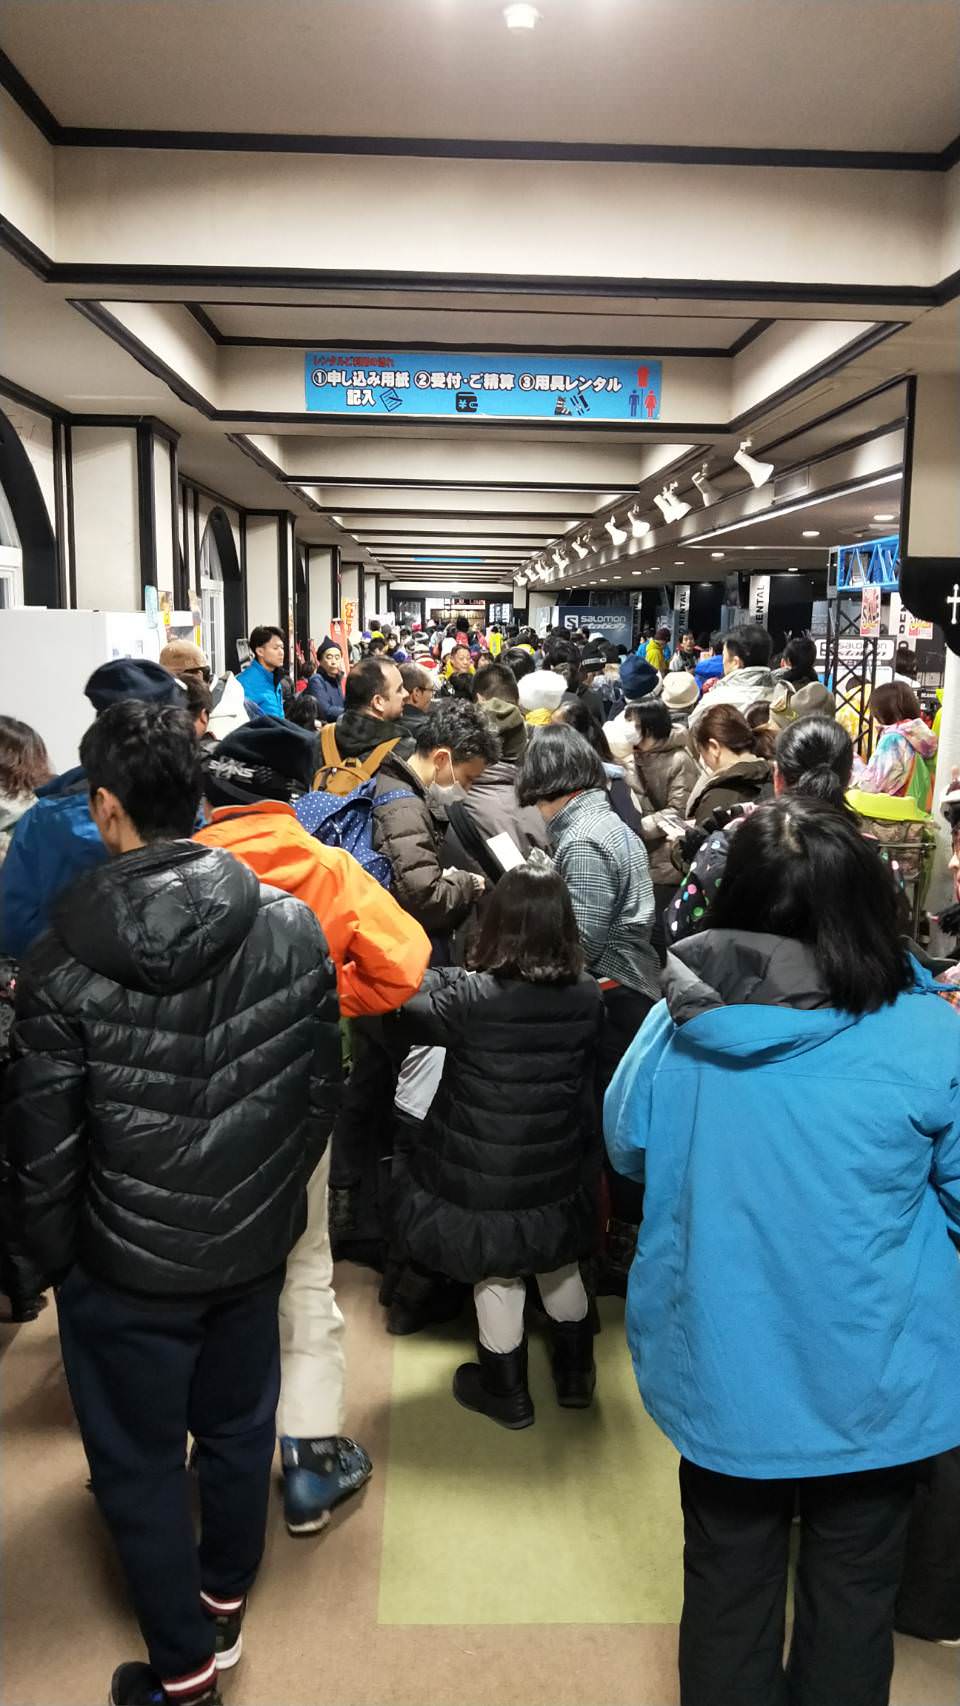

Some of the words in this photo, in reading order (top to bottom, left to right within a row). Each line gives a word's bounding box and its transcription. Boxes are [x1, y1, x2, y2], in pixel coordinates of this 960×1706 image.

[312, 369, 410, 389] ①申し込み用紙
[519, 373, 623, 393] ③用具レンタル
[346, 388, 376, 406] 記入
